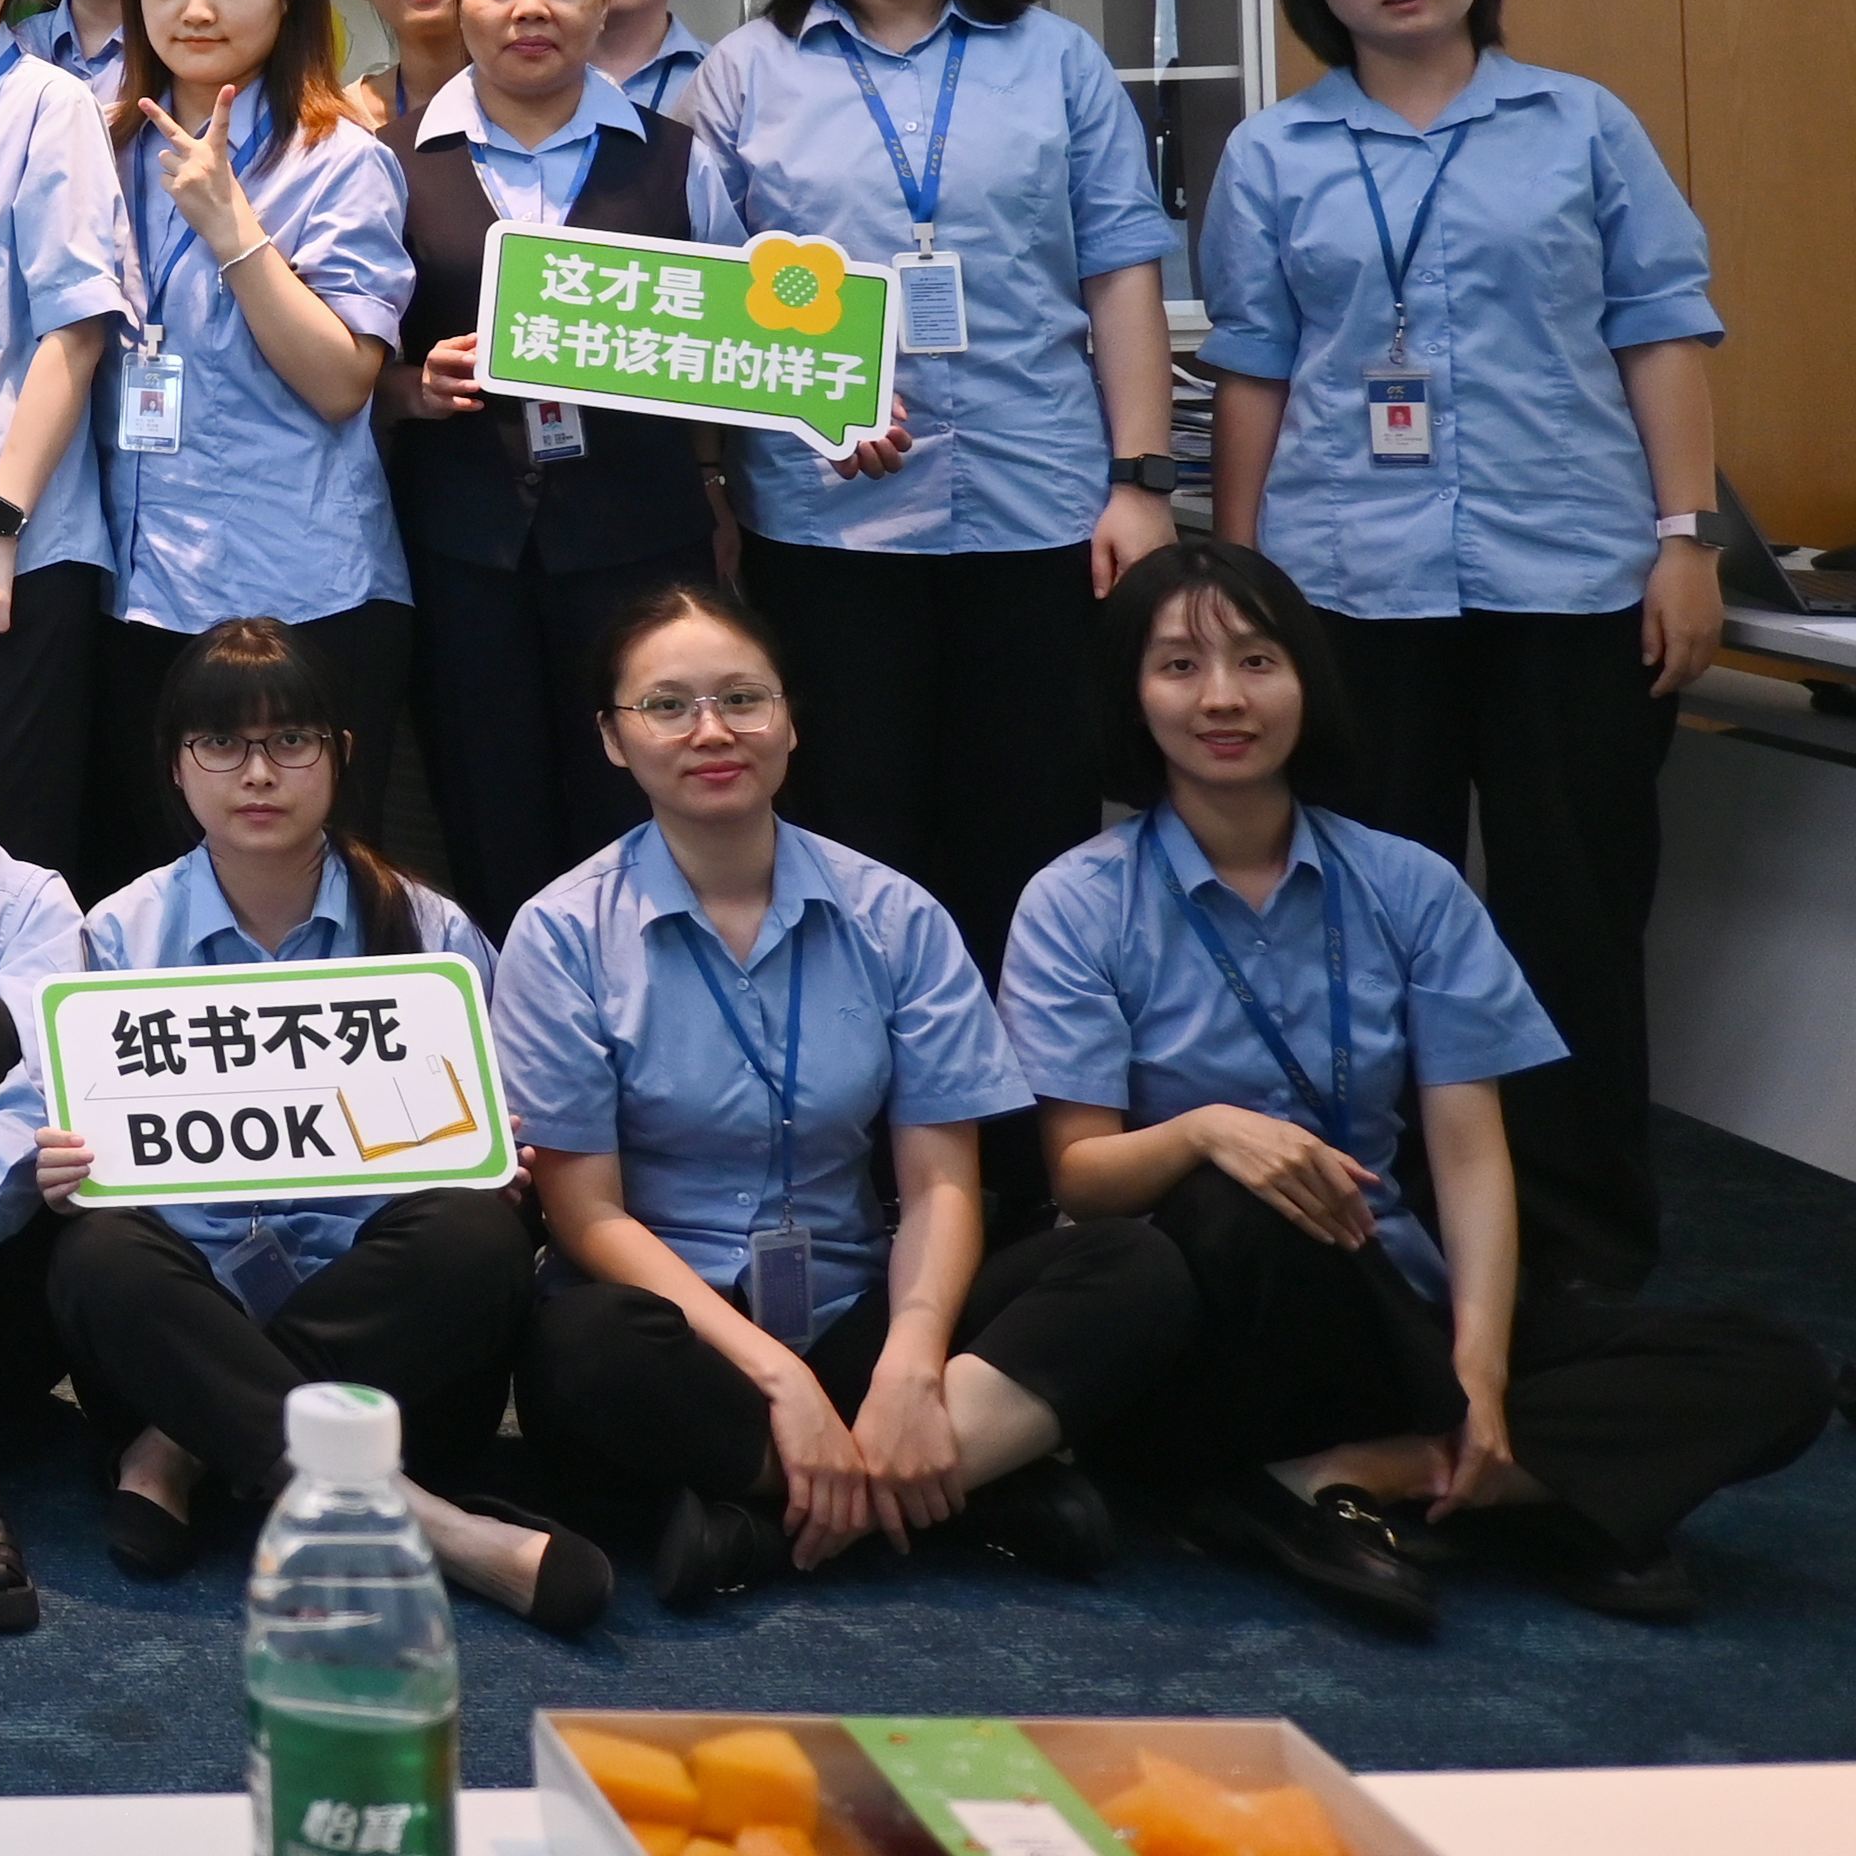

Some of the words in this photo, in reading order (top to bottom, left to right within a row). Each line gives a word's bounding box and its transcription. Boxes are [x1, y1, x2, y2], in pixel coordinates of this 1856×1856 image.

[540, 253, 705, 321] 这才是
[509, 312, 866, 400] 读书该有的样子
[111, 998, 407, 1078] 纸书不死
[127, 1103, 336, 1167] BOOK
